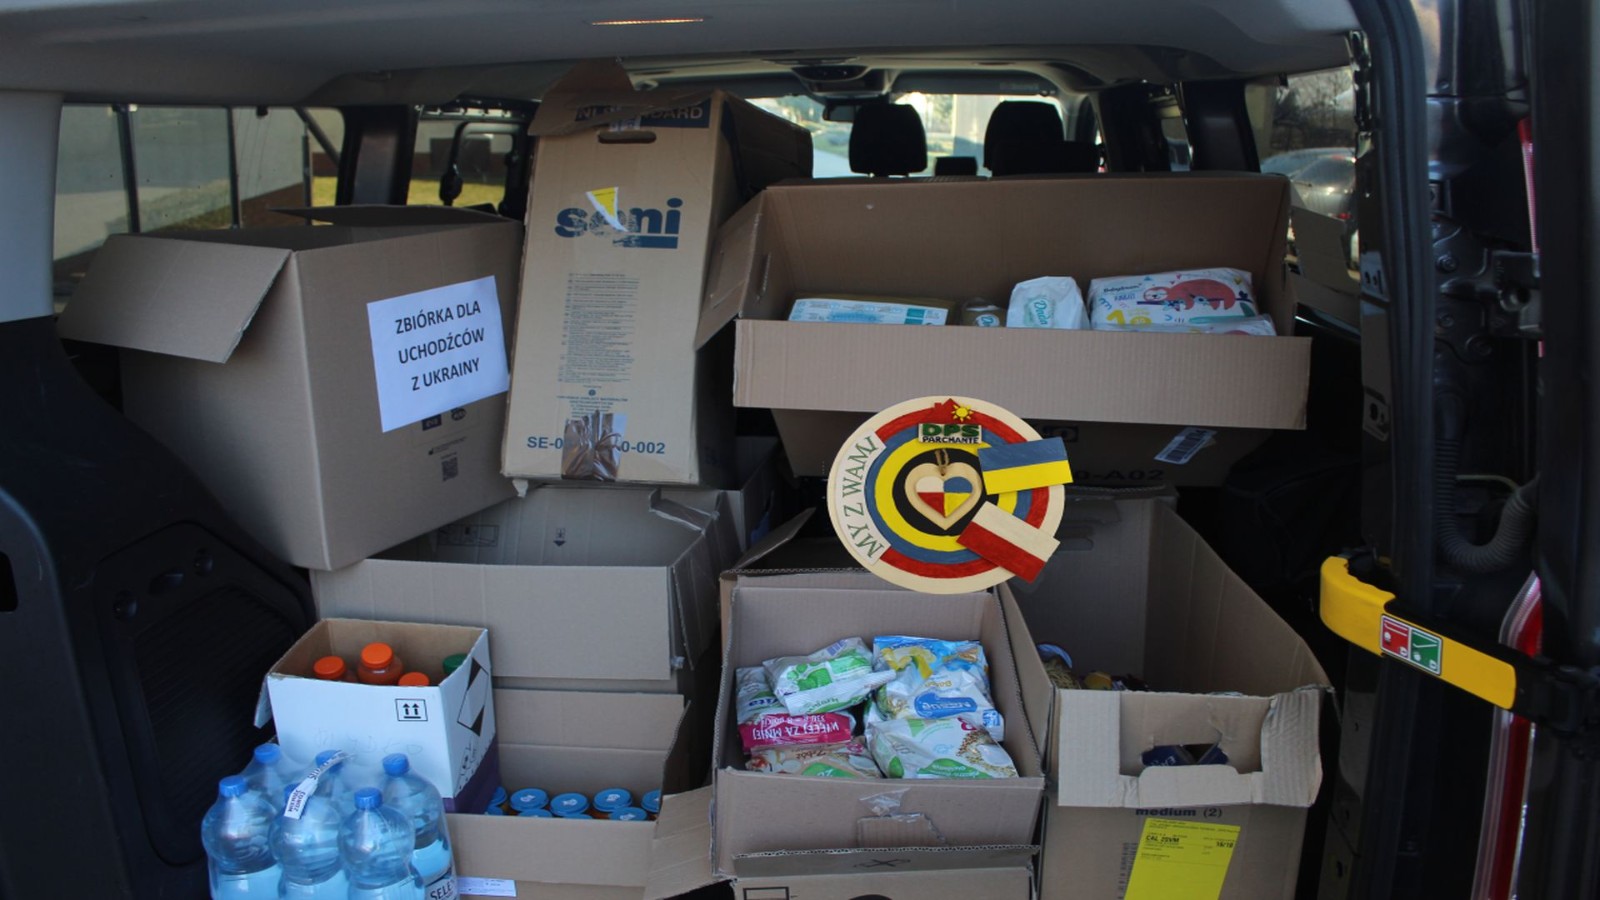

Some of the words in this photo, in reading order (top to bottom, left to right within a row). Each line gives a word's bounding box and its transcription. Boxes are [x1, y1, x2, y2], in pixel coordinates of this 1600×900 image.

[395, 307, 454, 335] ZBIÓRKA
[457, 300, 481, 318] DLA
[398, 327, 485, 364] UCHODŹCÓW
[411, 376, 420, 391] Z
[423, 357, 480, 387] UKRAINY
[922, 423, 980, 437] DPS
[922, 436, 979, 444] PARCHANTE
[842, 436, 880, 499] WAMI
[843, 502, 864, 517] Z
[847, 522, 885, 559] MY
[752, 727, 782, 740] MNIEJ
[785, 726, 799, 736] ZA
[1135, 807, 1197, 817] medium
[1203, 808, 1223, 818] (2)
